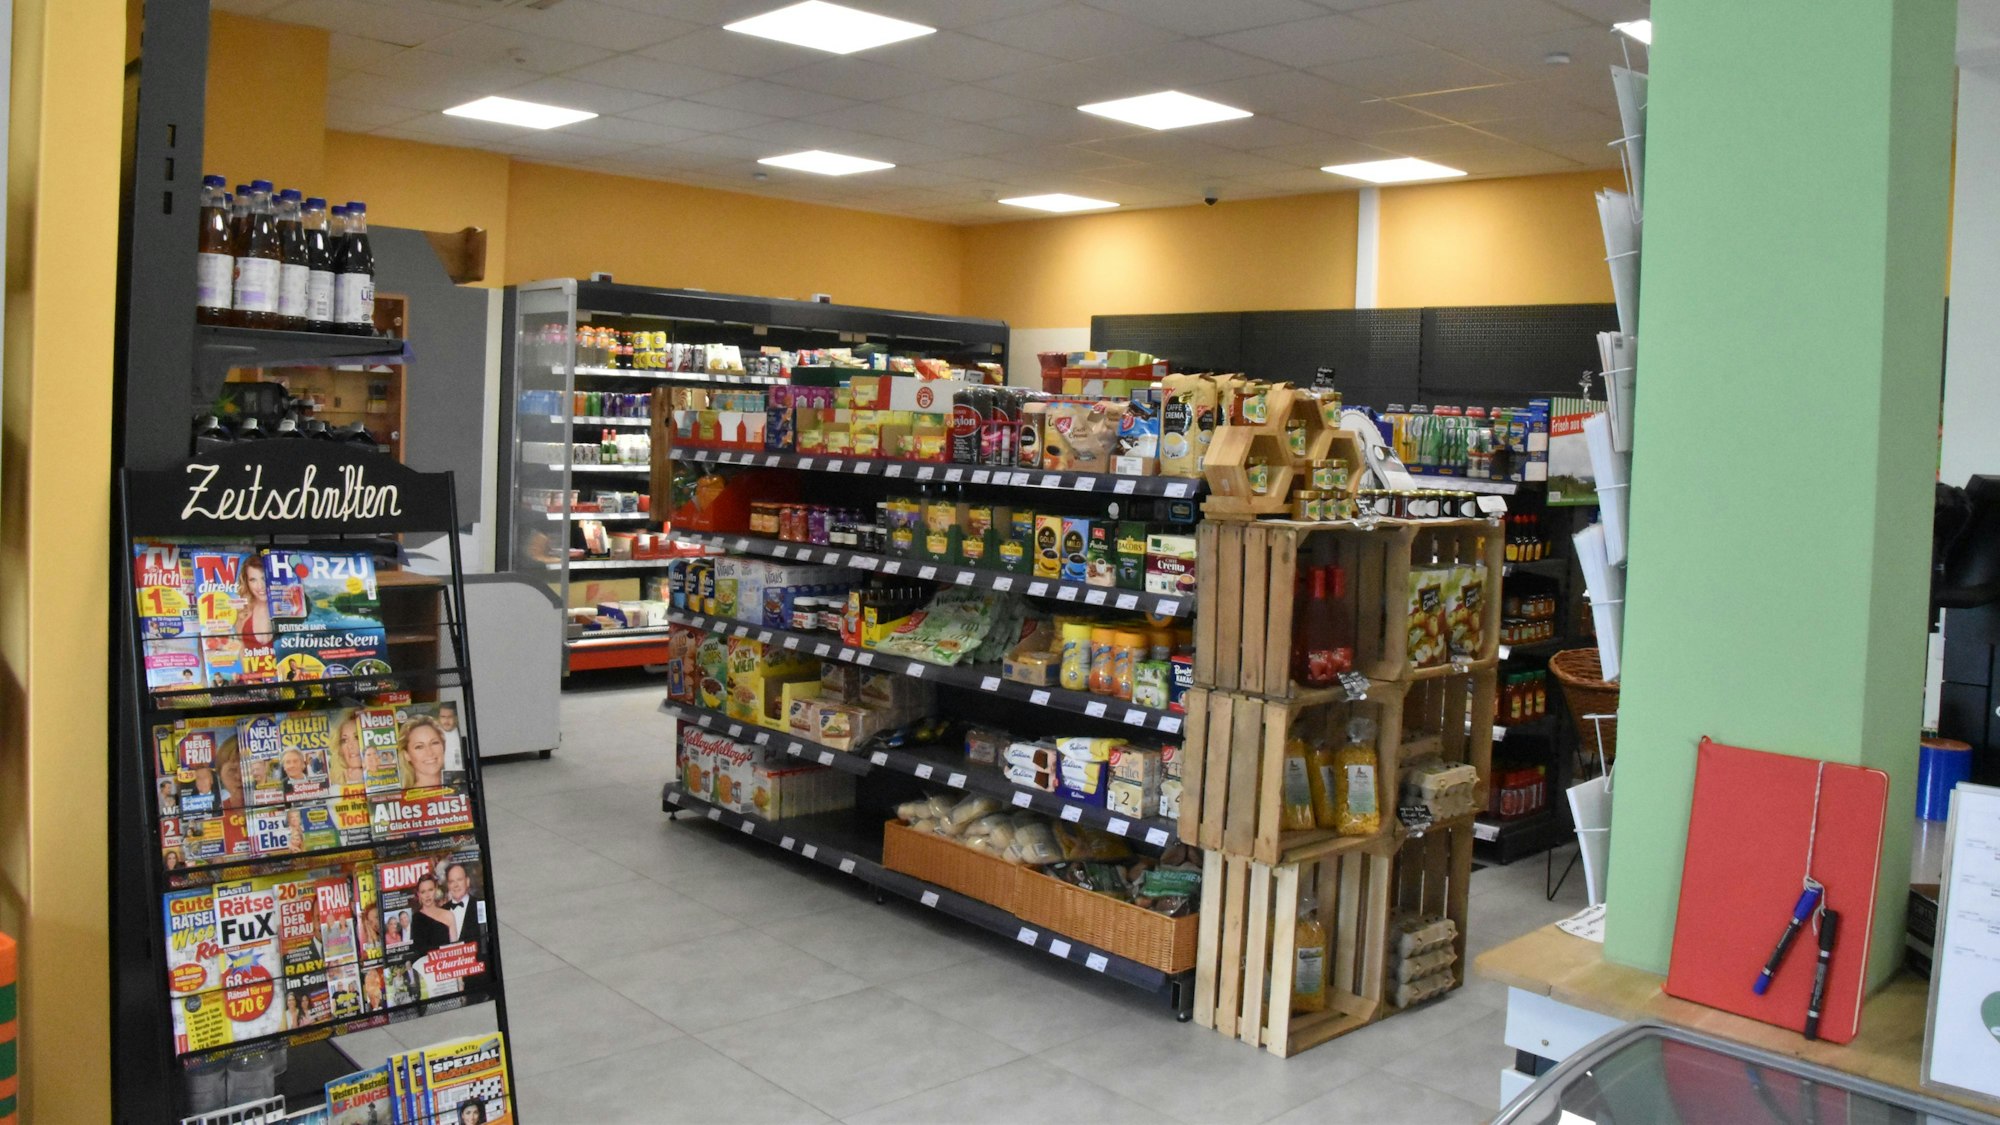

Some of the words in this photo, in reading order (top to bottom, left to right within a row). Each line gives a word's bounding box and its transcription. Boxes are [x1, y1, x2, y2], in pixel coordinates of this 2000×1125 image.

[181, 463, 402, 522] Zeitschriften
[1118, 542, 1143, 552] JACOBS
[144, 546, 181, 571] TV
[1157, 559, 1185, 573] Crema
[143, 569, 181, 587] mich
[195, 556, 240, 585] TV
[198, 579, 239, 594] direkt
[280, 633, 344, 649] schönste
[345, 632, 379, 647] Seen
[280, 715, 328, 735] FREIZEIT
[360, 712, 394, 728] Neue
[249, 726, 278, 740] NEUE
[281, 732, 330, 750] SPASS
[362, 729, 397, 746] Post
[184, 738, 212, 750] NEUE
[185, 748, 212, 765] FRAU
[711, 739, 754, 767] Kellogg's
[1121, 791, 1130, 806] 2
[374, 801, 423, 824] Alles
[427, 793, 468, 817] aus!
[164, 821, 175, 836] 2
[258, 819, 280, 832] Das
[374, 824, 388, 834] Ihr
[389, 821, 412, 831] Glück
[412, 819, 422, 828] ist
[424, 815, 469, 827] zerbrochen
[260, 832, 288, 849] Ehe
[383, 861, 430, 889] BUNTE
[278, 883, 297, 900] 20
[316, 882, 350, 912] FRAU
[171, 896, 214, 914] Gute
[219, 896, 274, 918] Rätse
[281, 900, 312, 916] ECHO
[172, 910, 216, 931] RÄTSEL
[221, 912, 275, 945] FuX
[282, 914, 306, 928] DER
[283, 922, 315, 938] FRAU
[428, 948, 463, 961] Warum
[463, 944, 477, 954] tut
[425, 964, 435, 973] er
[436, 971, 452, 981] das
[452, 968, 469, 978] nur
[286, 978, 301, 990] im
[226, 987, 250, 1000] Rätsel
[228, 997, 255, 1018] 1,70
[255, 995, 266, 1011] €
[433, 1048, 500, 1073] SPEZIAL
